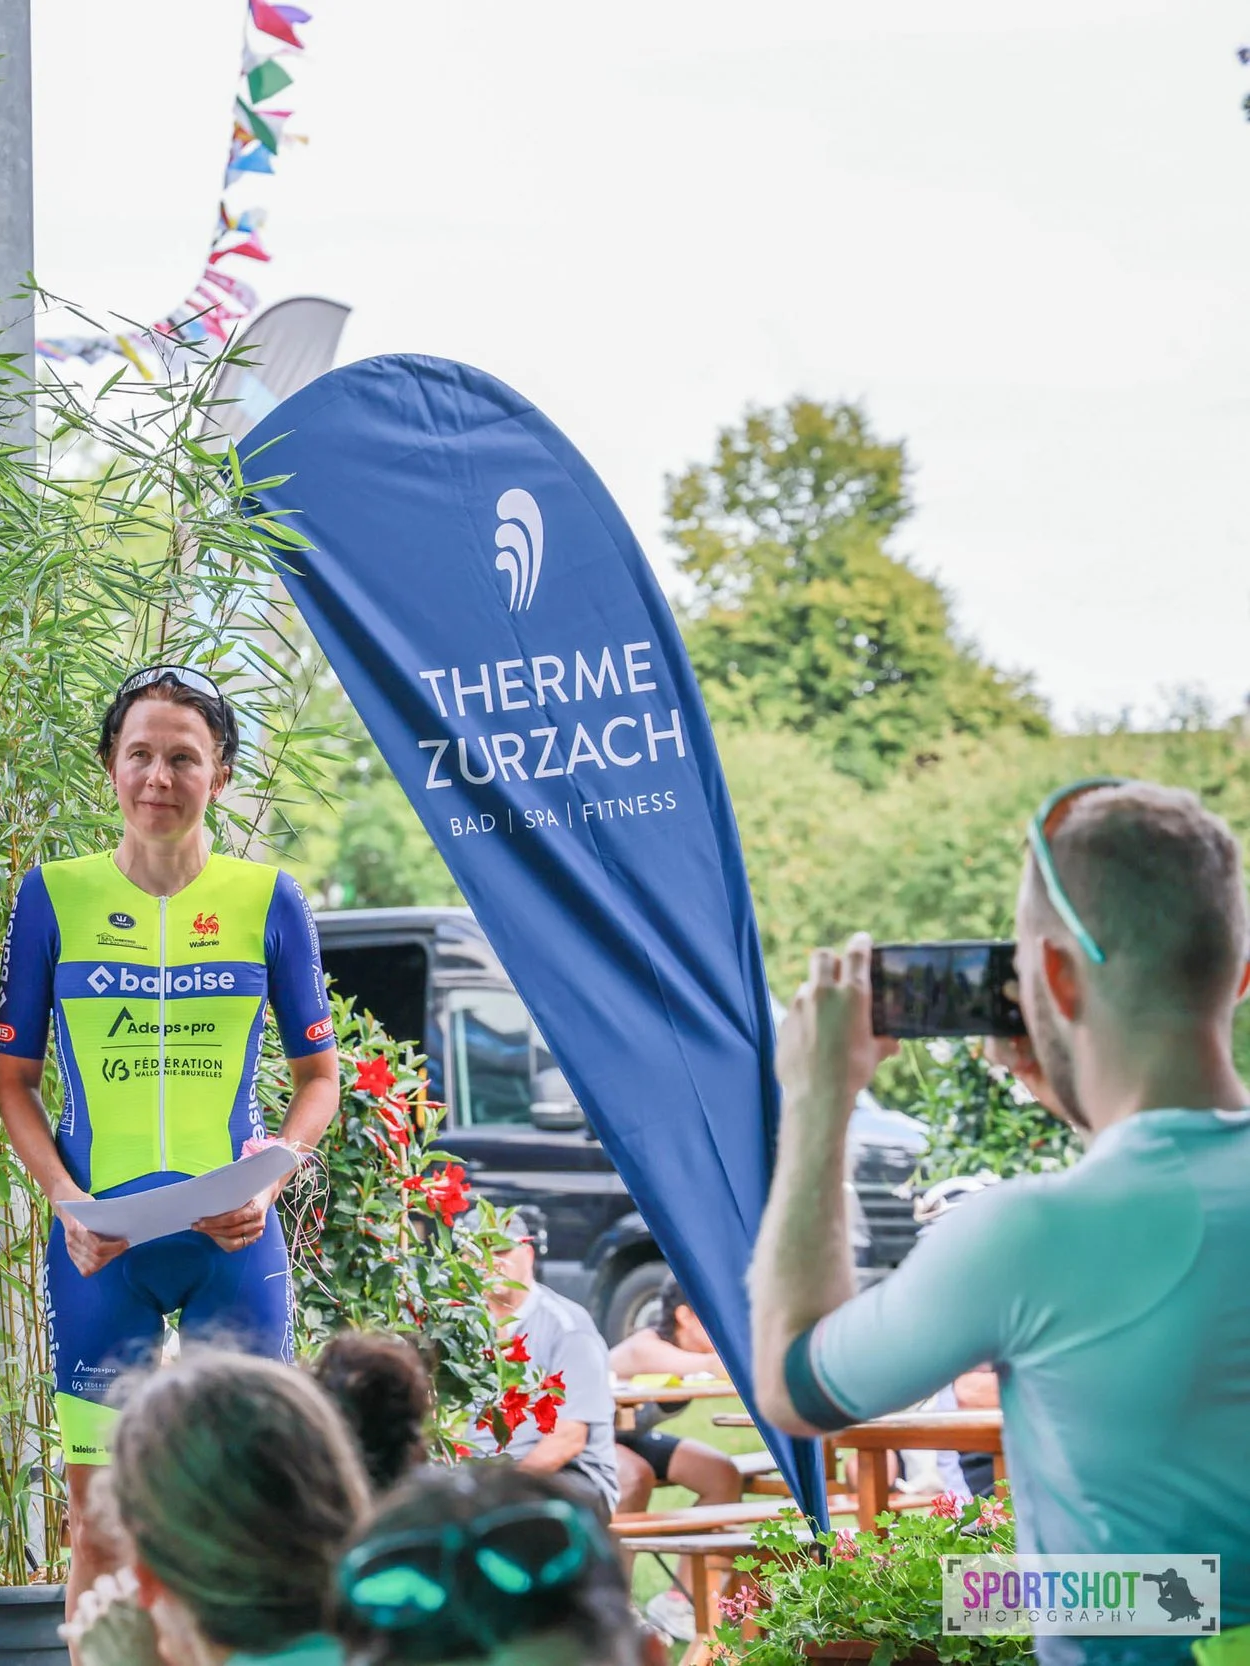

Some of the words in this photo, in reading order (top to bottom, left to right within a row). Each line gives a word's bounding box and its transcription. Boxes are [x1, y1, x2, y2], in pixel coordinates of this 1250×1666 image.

[419, 641, 656, 718] THERME
[418, 709, 686, 789] ZURZACH
[450, 813, 496, 836] BAD
[524, 808, 559, 829] SPA
[583, 791, 677, 822] FITNESS
[189, 940, 220, 948] Wallonie
[119, 966, 236, 993] baloise
[134, 1056, 223, 1070] FÉDÉRATION
[134, 1069, 223, 1079] WALLONIE-BRUXELLES
